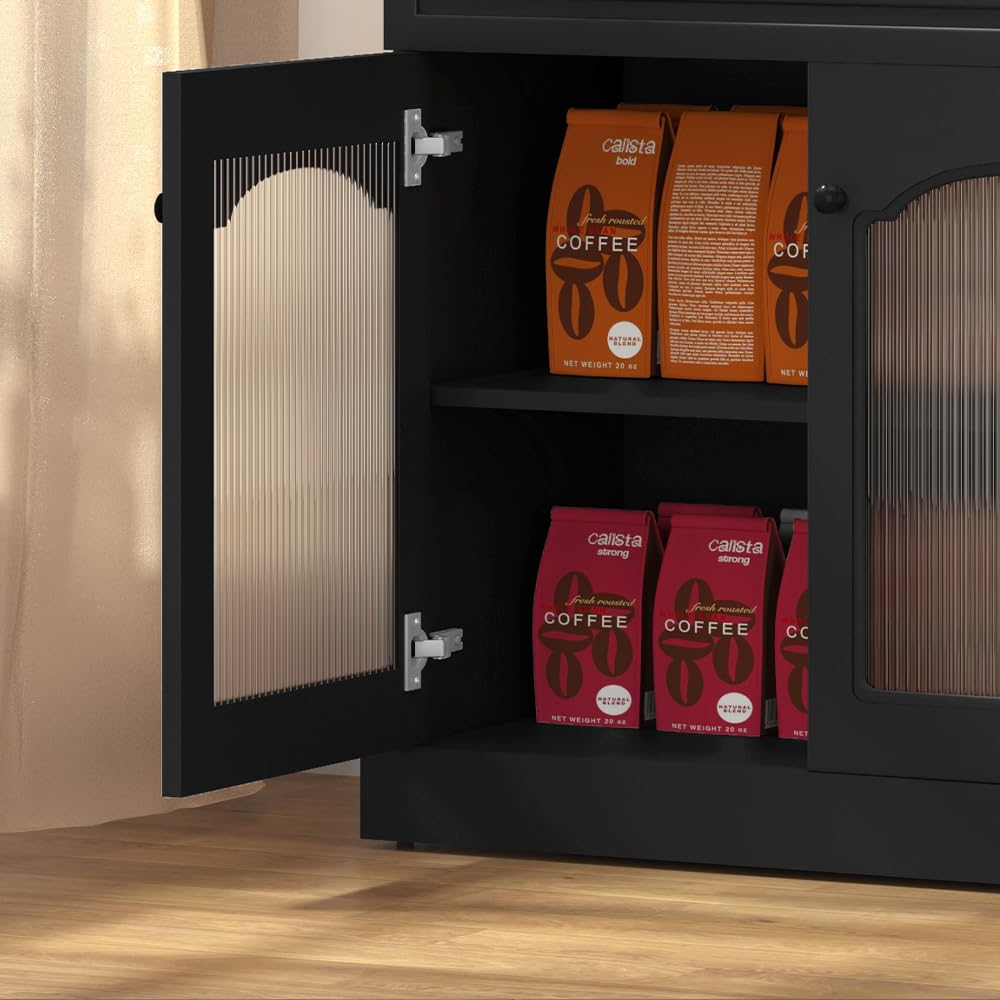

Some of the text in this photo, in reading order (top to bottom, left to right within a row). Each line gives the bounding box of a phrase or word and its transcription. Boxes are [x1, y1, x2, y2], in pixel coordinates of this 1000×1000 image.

[616, 156, 637, 166] bold
[577, 213, 647, 227] fresh roasted
[556, 234, 638, 252] COFFEE
[581, 361, 613, 369] WEIGHT
[597, 548, 630, 560] strong
[717, 555, 751, 567] strong
[565, 595, 637, 607] fresh roasted
[685, 602, 758, 615] fresh roasted
[544, 611, 628, 629] COFFEE
[664, 619, 749, 636] COFFEE
[569, 716, 601, 725] WEIGHT
[689, 724, 722, 733] WEIGHT
[793, 729, 808, 737] NET
